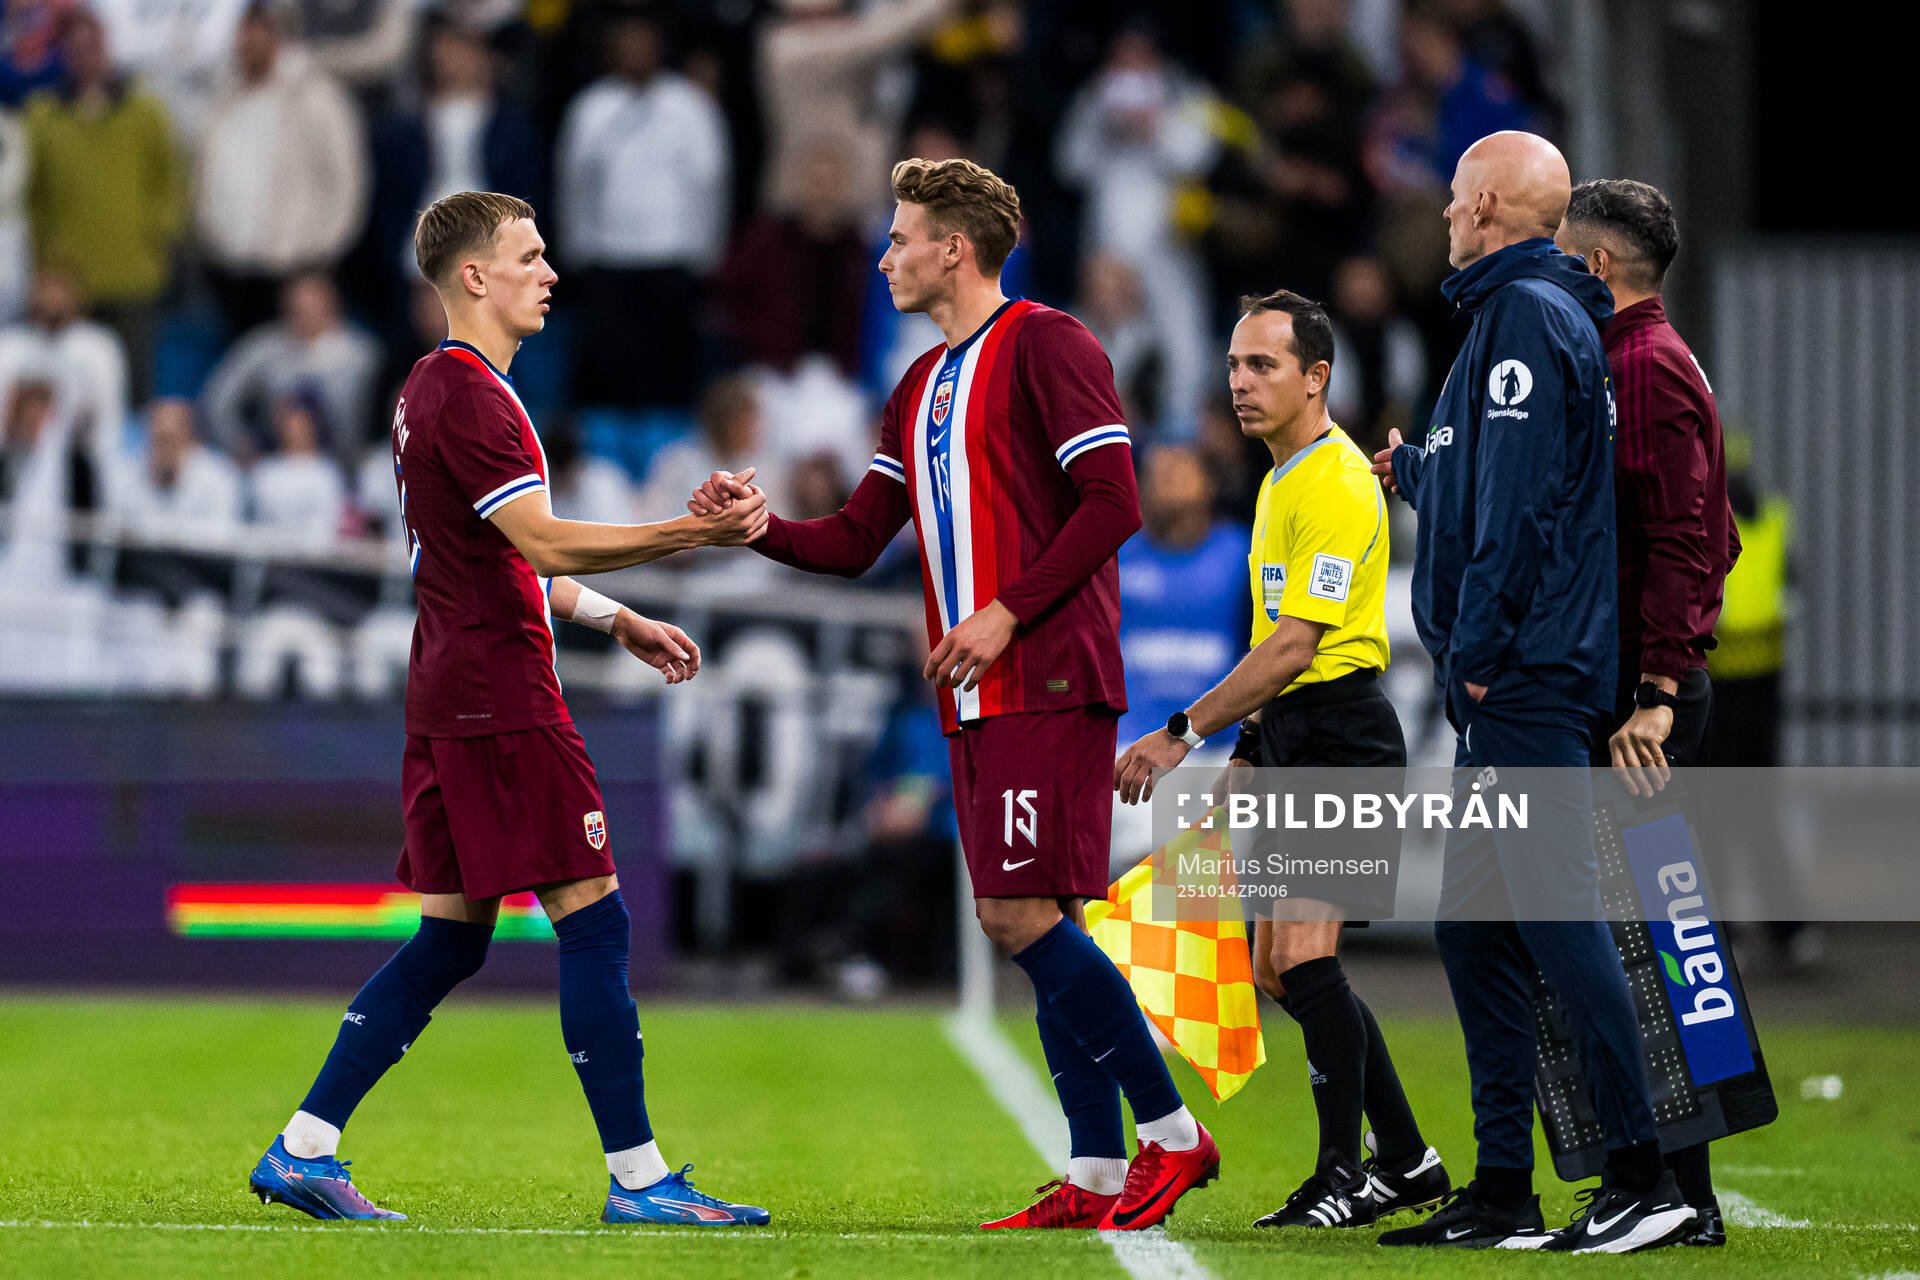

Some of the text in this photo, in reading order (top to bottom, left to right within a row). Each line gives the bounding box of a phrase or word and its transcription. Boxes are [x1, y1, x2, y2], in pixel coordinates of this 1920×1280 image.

[1487, 408, 1529, 420] Gjensidige
[932, 452, 950, 513] 15
[1262, 567, 1283, 581] FIFA
[1321, 568, 1343, 579] UNITES
[1001, 789, 1038, 848] 15
[1657, 860, 1735, 1026] bama
